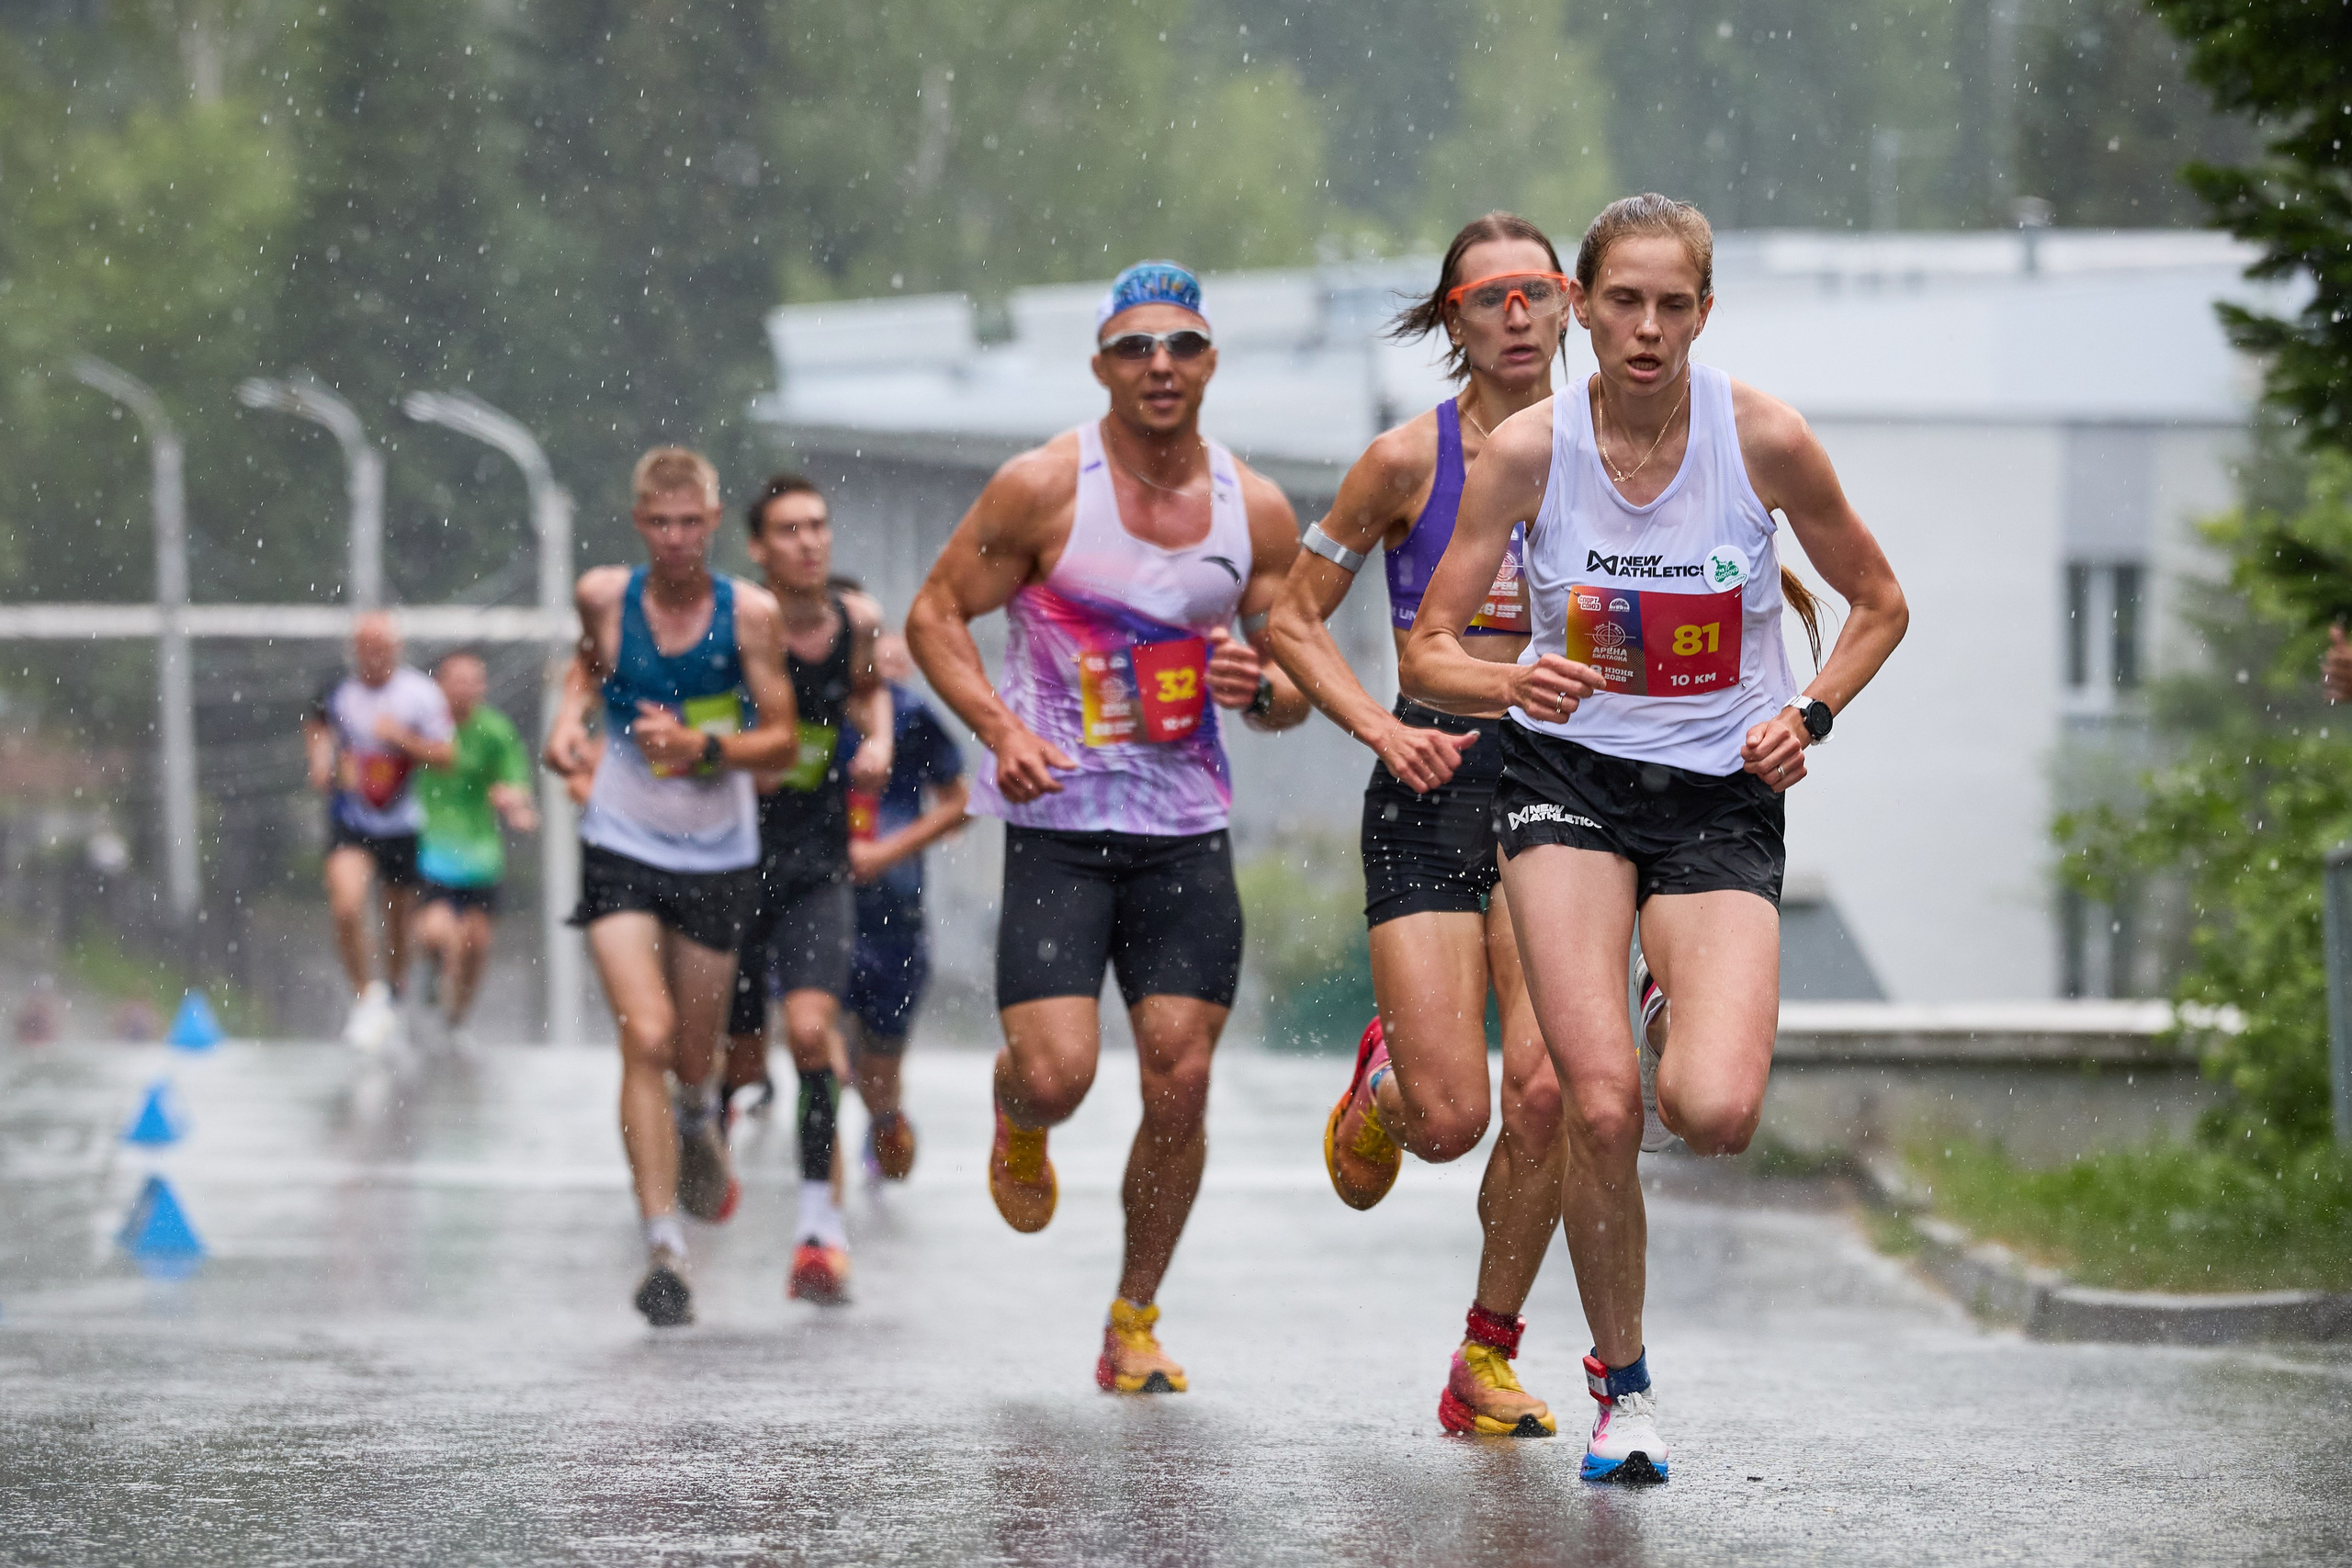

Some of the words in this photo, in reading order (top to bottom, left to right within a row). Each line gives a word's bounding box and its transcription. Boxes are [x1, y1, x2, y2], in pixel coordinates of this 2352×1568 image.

[1620, 555, 1663, 567] NEW
[1714, 567, 1739, 581] bionova
[1671, 621, 1720, 656] 81
[1592, 653, 1628, 662] БИАТЛОНА
[1593, 647, 1628, 657] АРЕНА
[1604, 666, 1634, 678] ИЮНЯ
[1670, 674, 1690, 686] 10
[1694, 671, 1717, 684] КМ
[1154, 668, 1197, 703] 32
[1530, 804, 1565, 814] NEW
